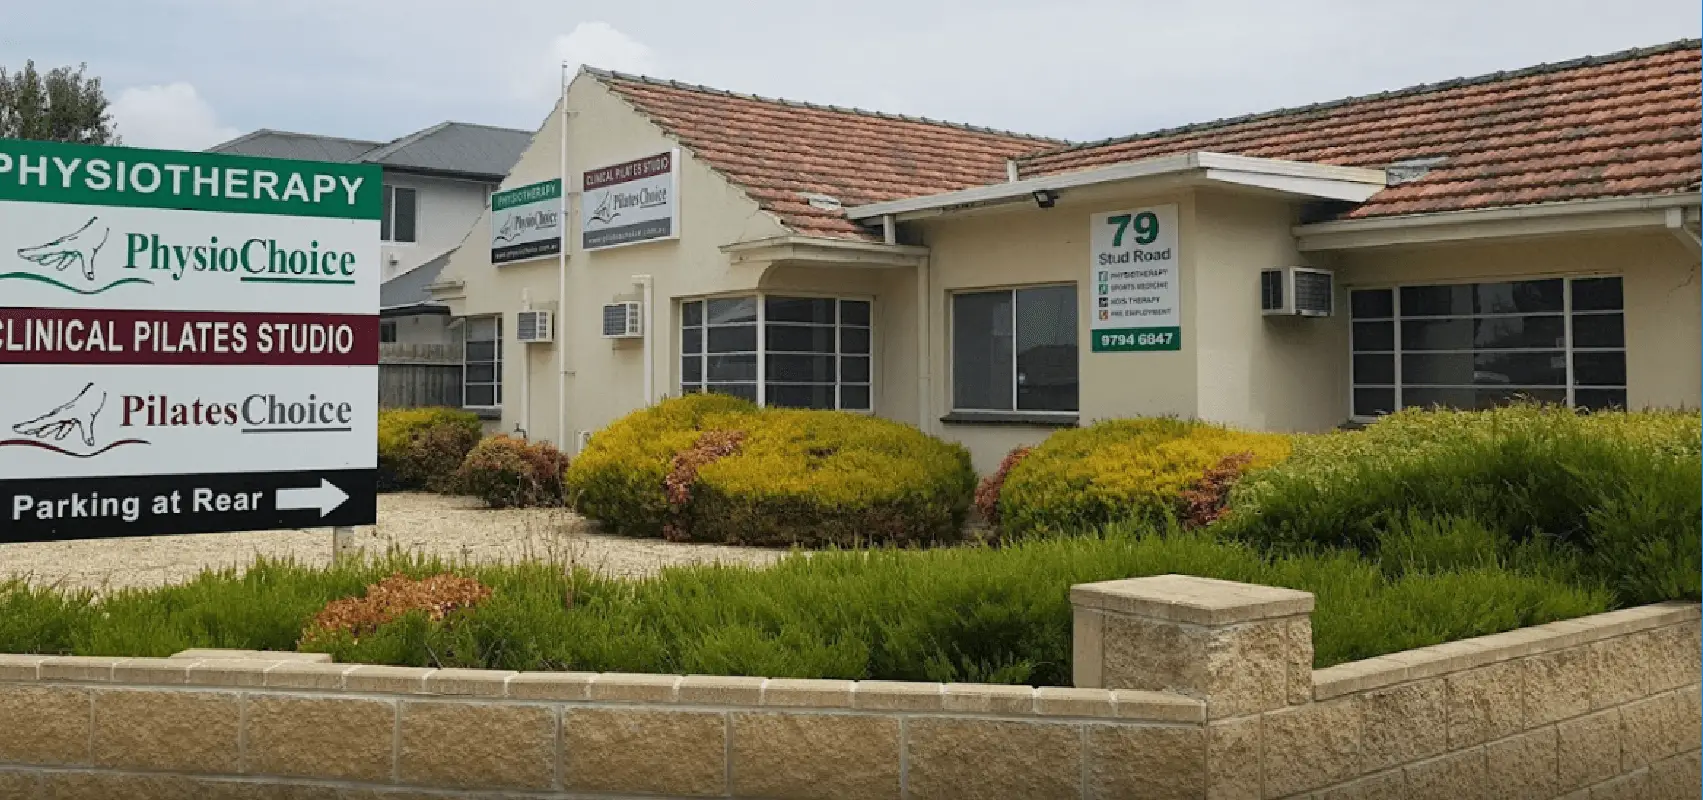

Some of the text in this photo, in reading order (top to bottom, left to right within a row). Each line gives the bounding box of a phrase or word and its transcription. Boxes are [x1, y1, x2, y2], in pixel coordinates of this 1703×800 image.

[586, 156, 669, 186] CLINICAL PILATES STUDIO
[1106, 211, 1160, 247] 79
[122, 232, 356, 280] PhysioChoice
[1099, 248, 1171, 265] Stud Road
[0, 318, 354, 354] LINICAL PILATES STUDIO
[1101, 332, 1173, 346] 9794 6847
[119, 393, 352, 427] PilatesChoice
[12, 488, 263, 522] Parking at Rear
